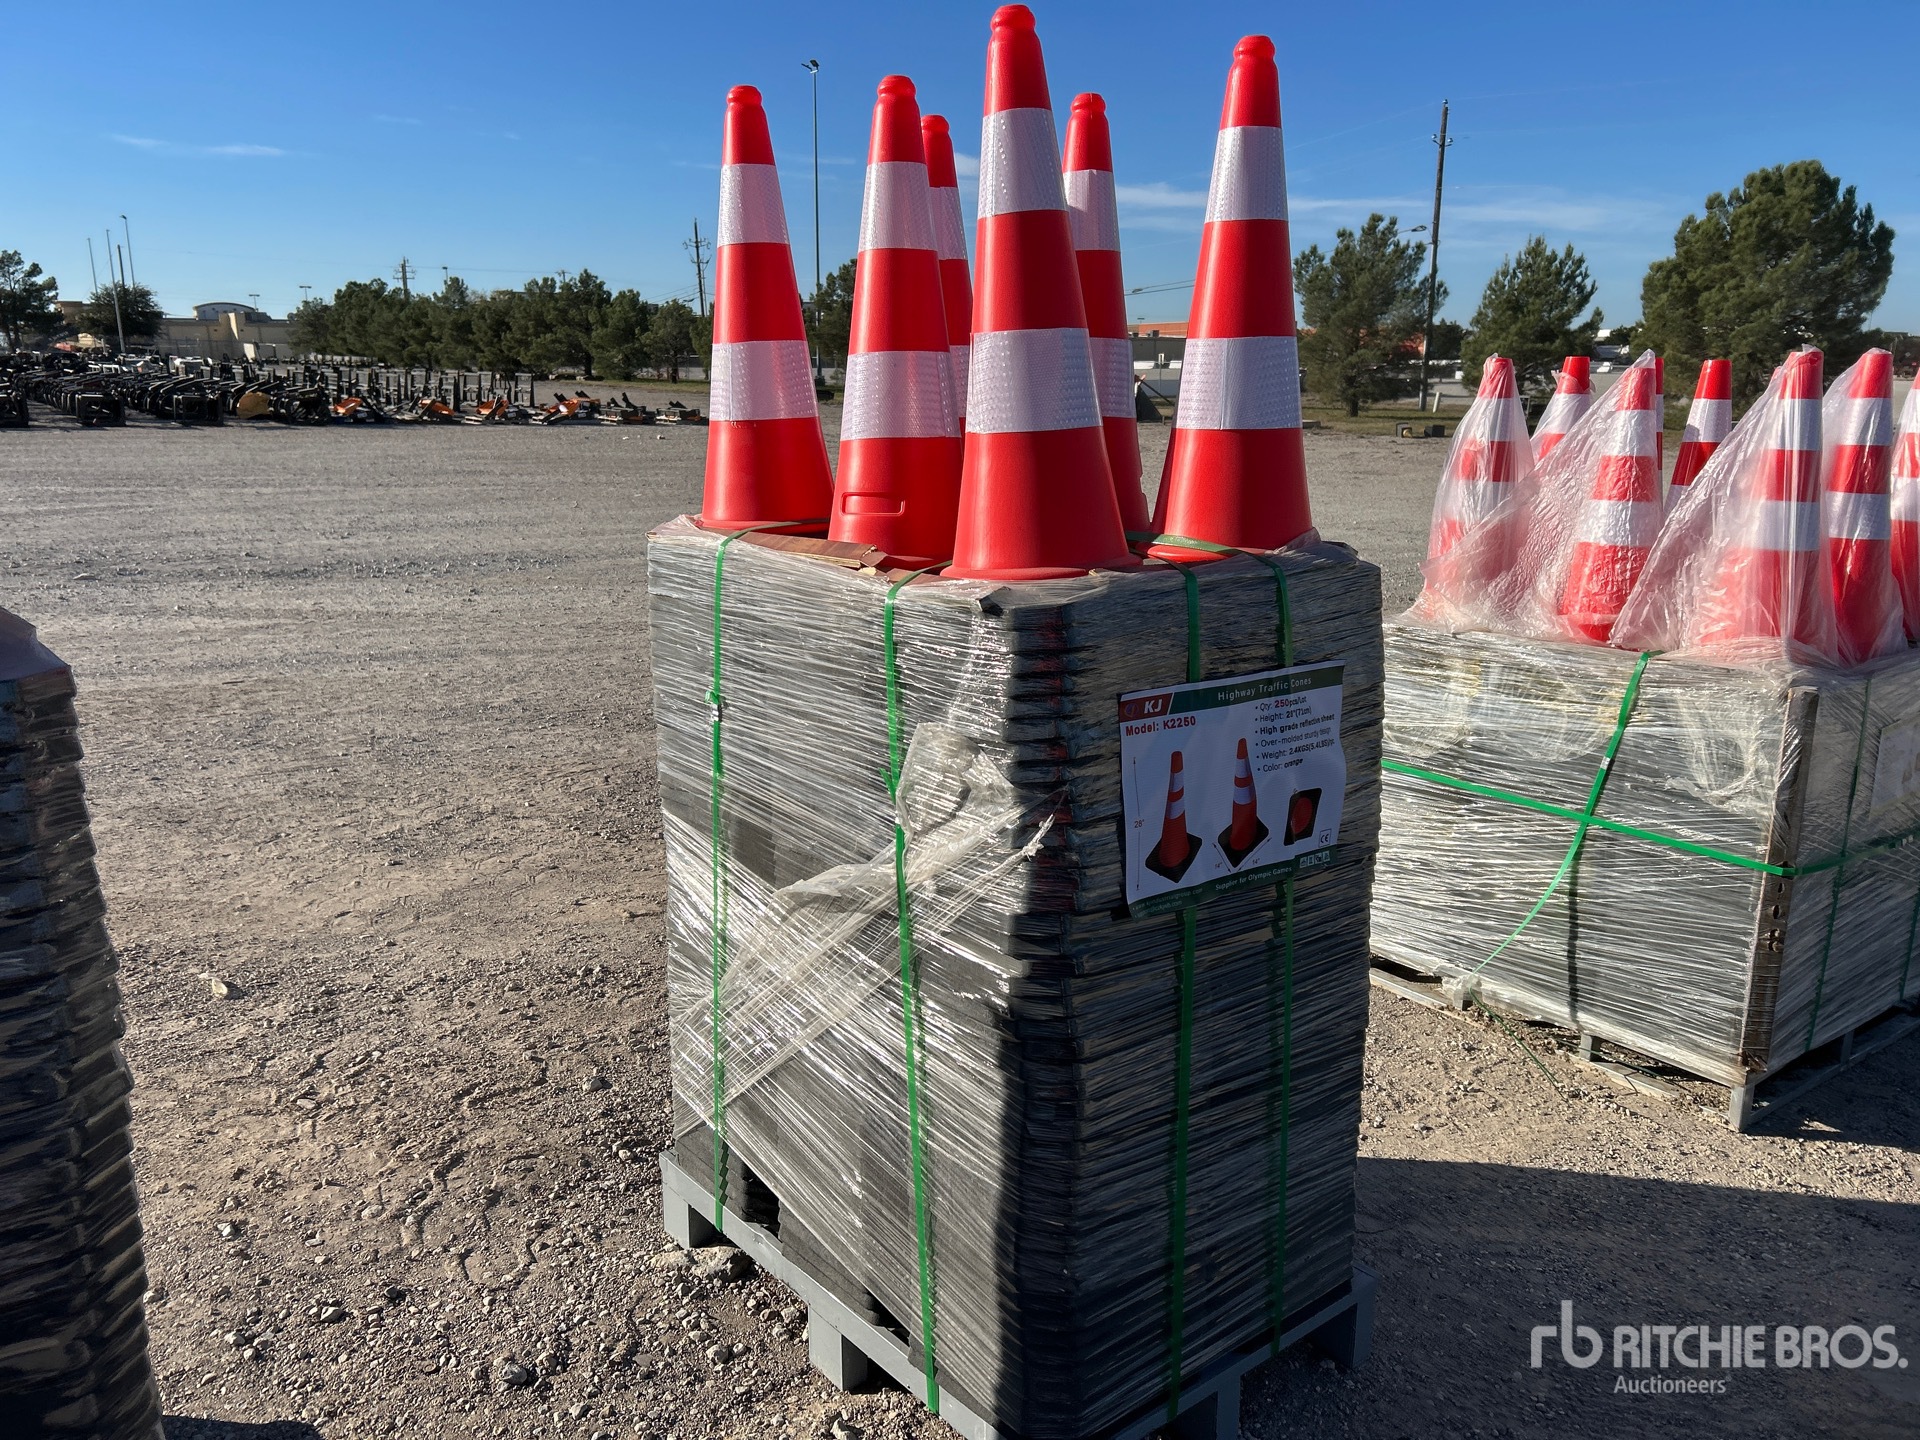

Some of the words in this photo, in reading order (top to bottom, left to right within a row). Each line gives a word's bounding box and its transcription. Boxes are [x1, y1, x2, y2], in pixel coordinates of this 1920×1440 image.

[1218, 688, 1256, 701] Highway
[1259, 681, 1288, 694] Traffic
[1291, 676, 1312, 688] Cones
[1143, 698, 1163, 714] KJ
[1125, 721, 1159, 736] Model:
[1163, 716, 1196, 730] K2250
[1260, 713, 1284, 723] Height:
[1260, 726, 1278, 736] High
[1279, 723, 1299, 734] grade
[1299, 717, 1321, 728] reflective
[1321, 713, 1335, 723] sheet
[1260, 733, 1303, 748] Over-molded
[1261, 749, 1288, 760] Weight:
[1262, 762, 1283, 773] Color:
[1283, 757, 1304, 768] orange
[1320, 833, 1330, 844] CE
[1215, 878, 1238, 891] Supplier
[1239, 876, 1247, 884] for
[1248, 870, 1272, 882] Olympic
[1272, 865, 1292, 877] Games
